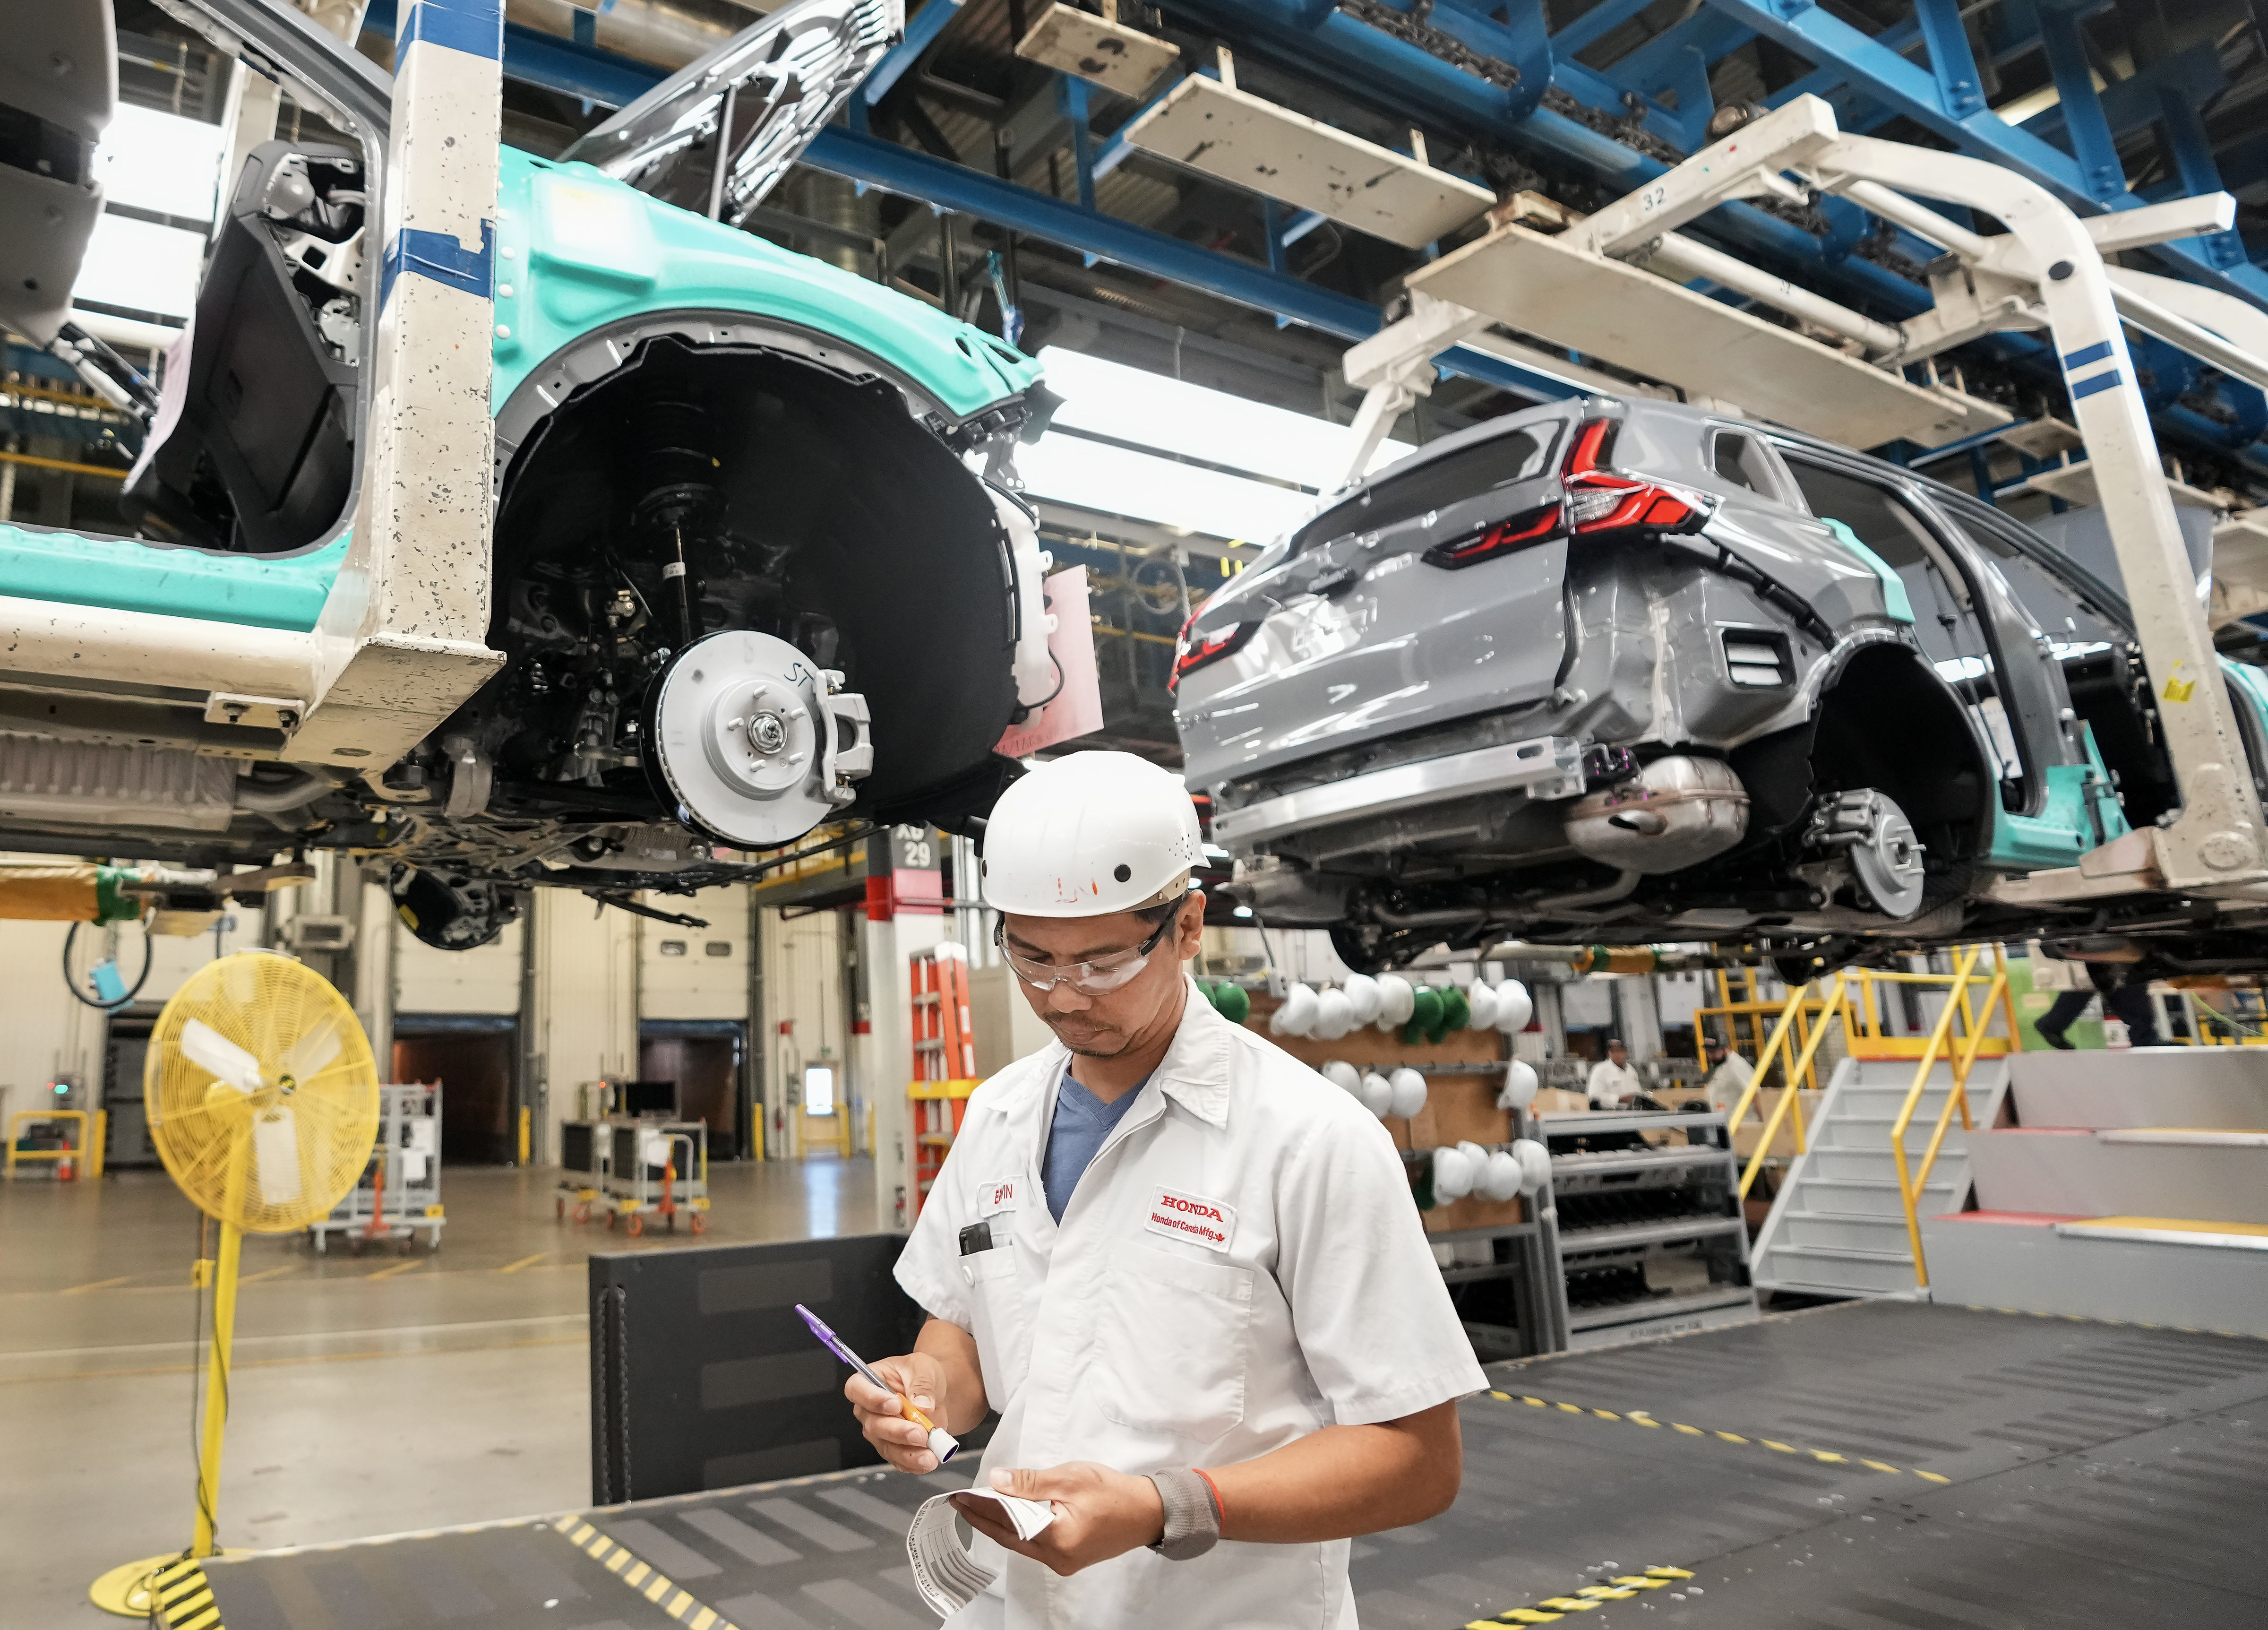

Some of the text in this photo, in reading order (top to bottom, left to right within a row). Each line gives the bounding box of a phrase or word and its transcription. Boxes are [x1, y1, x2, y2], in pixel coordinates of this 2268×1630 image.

[1642, 186, 1667, 211] 32
[784, 662, 815, 687] ST
[904, 841, 931, 867] 29
[1161, 1195, 1224, 1222] HONDA
[1151, 1212, 1172, 1227] Honda
[1172, 1220, 1181, 1229] of
[1199, 1225, 1215, 1240] Mfg.
